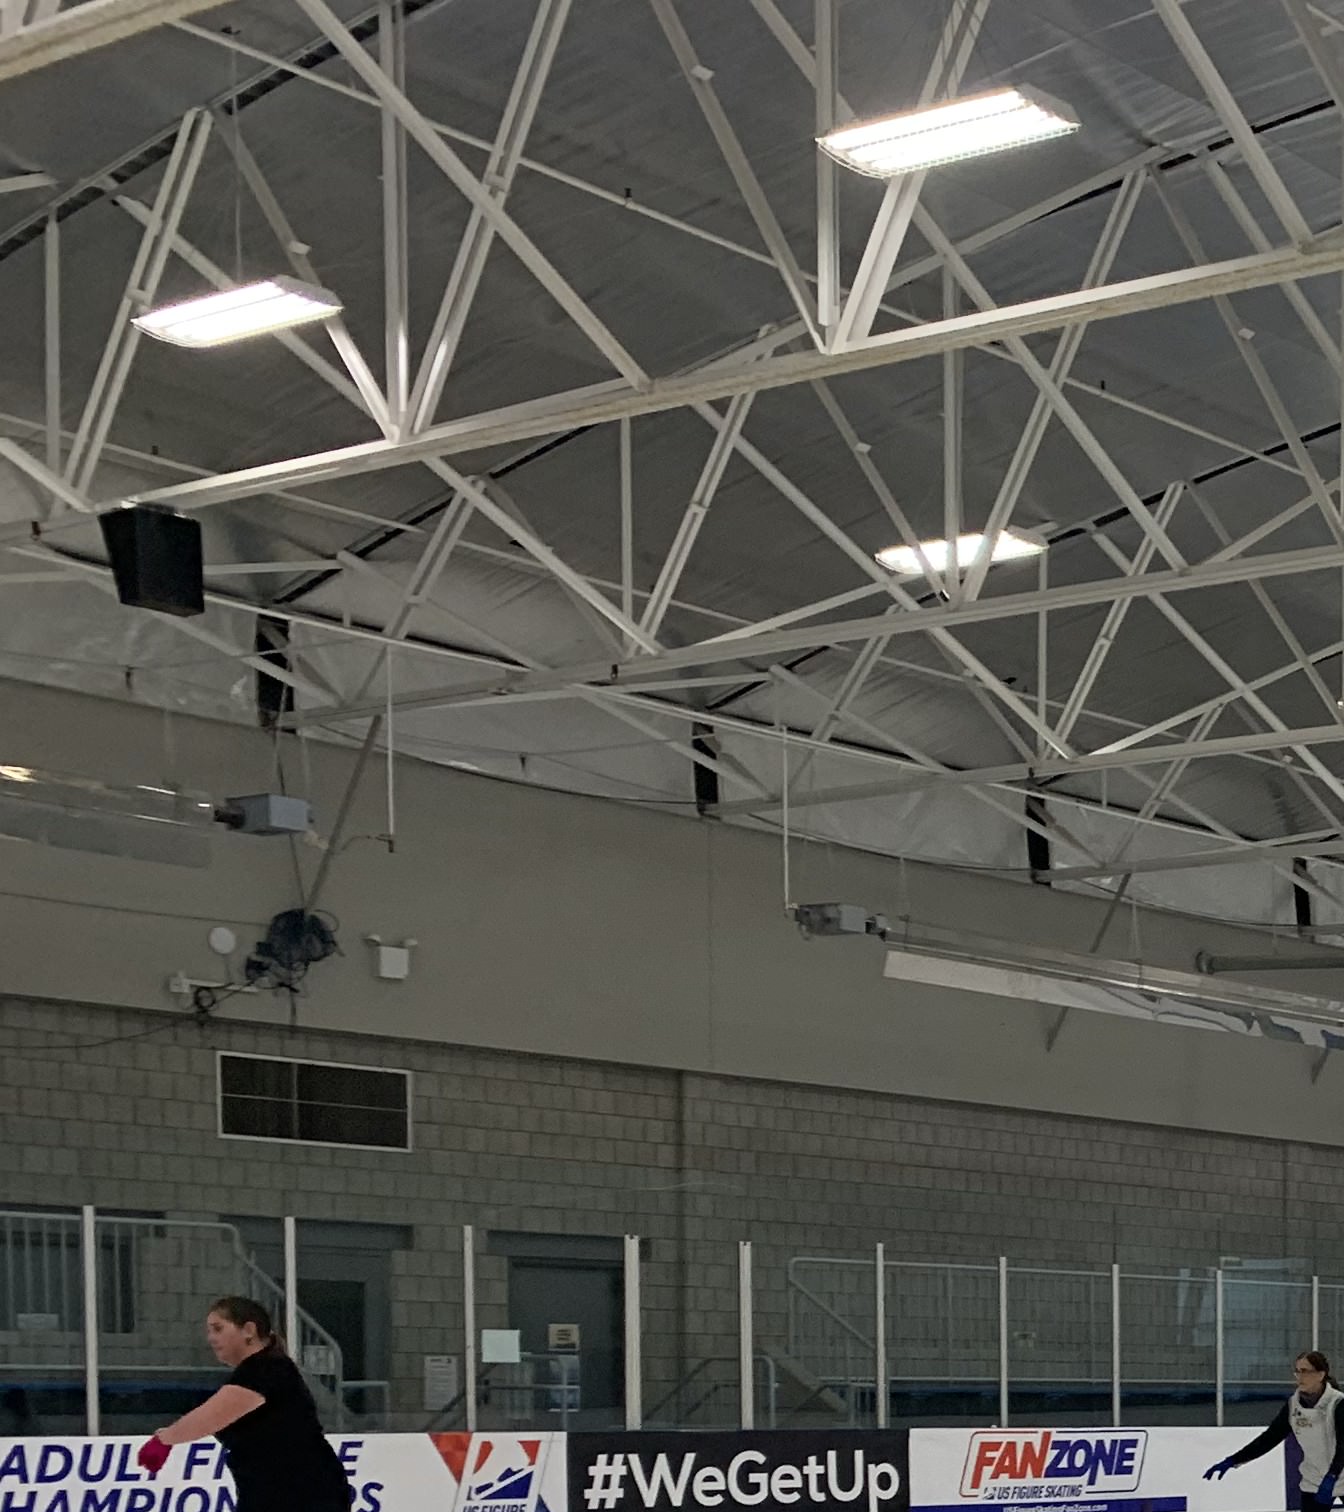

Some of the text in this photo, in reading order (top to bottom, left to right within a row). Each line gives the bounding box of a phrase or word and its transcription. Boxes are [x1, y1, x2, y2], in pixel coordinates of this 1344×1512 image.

[0, 1444, 157, 1484] ADUL
[997, 1484, 1083, 1499] US FIGURE SKATING
